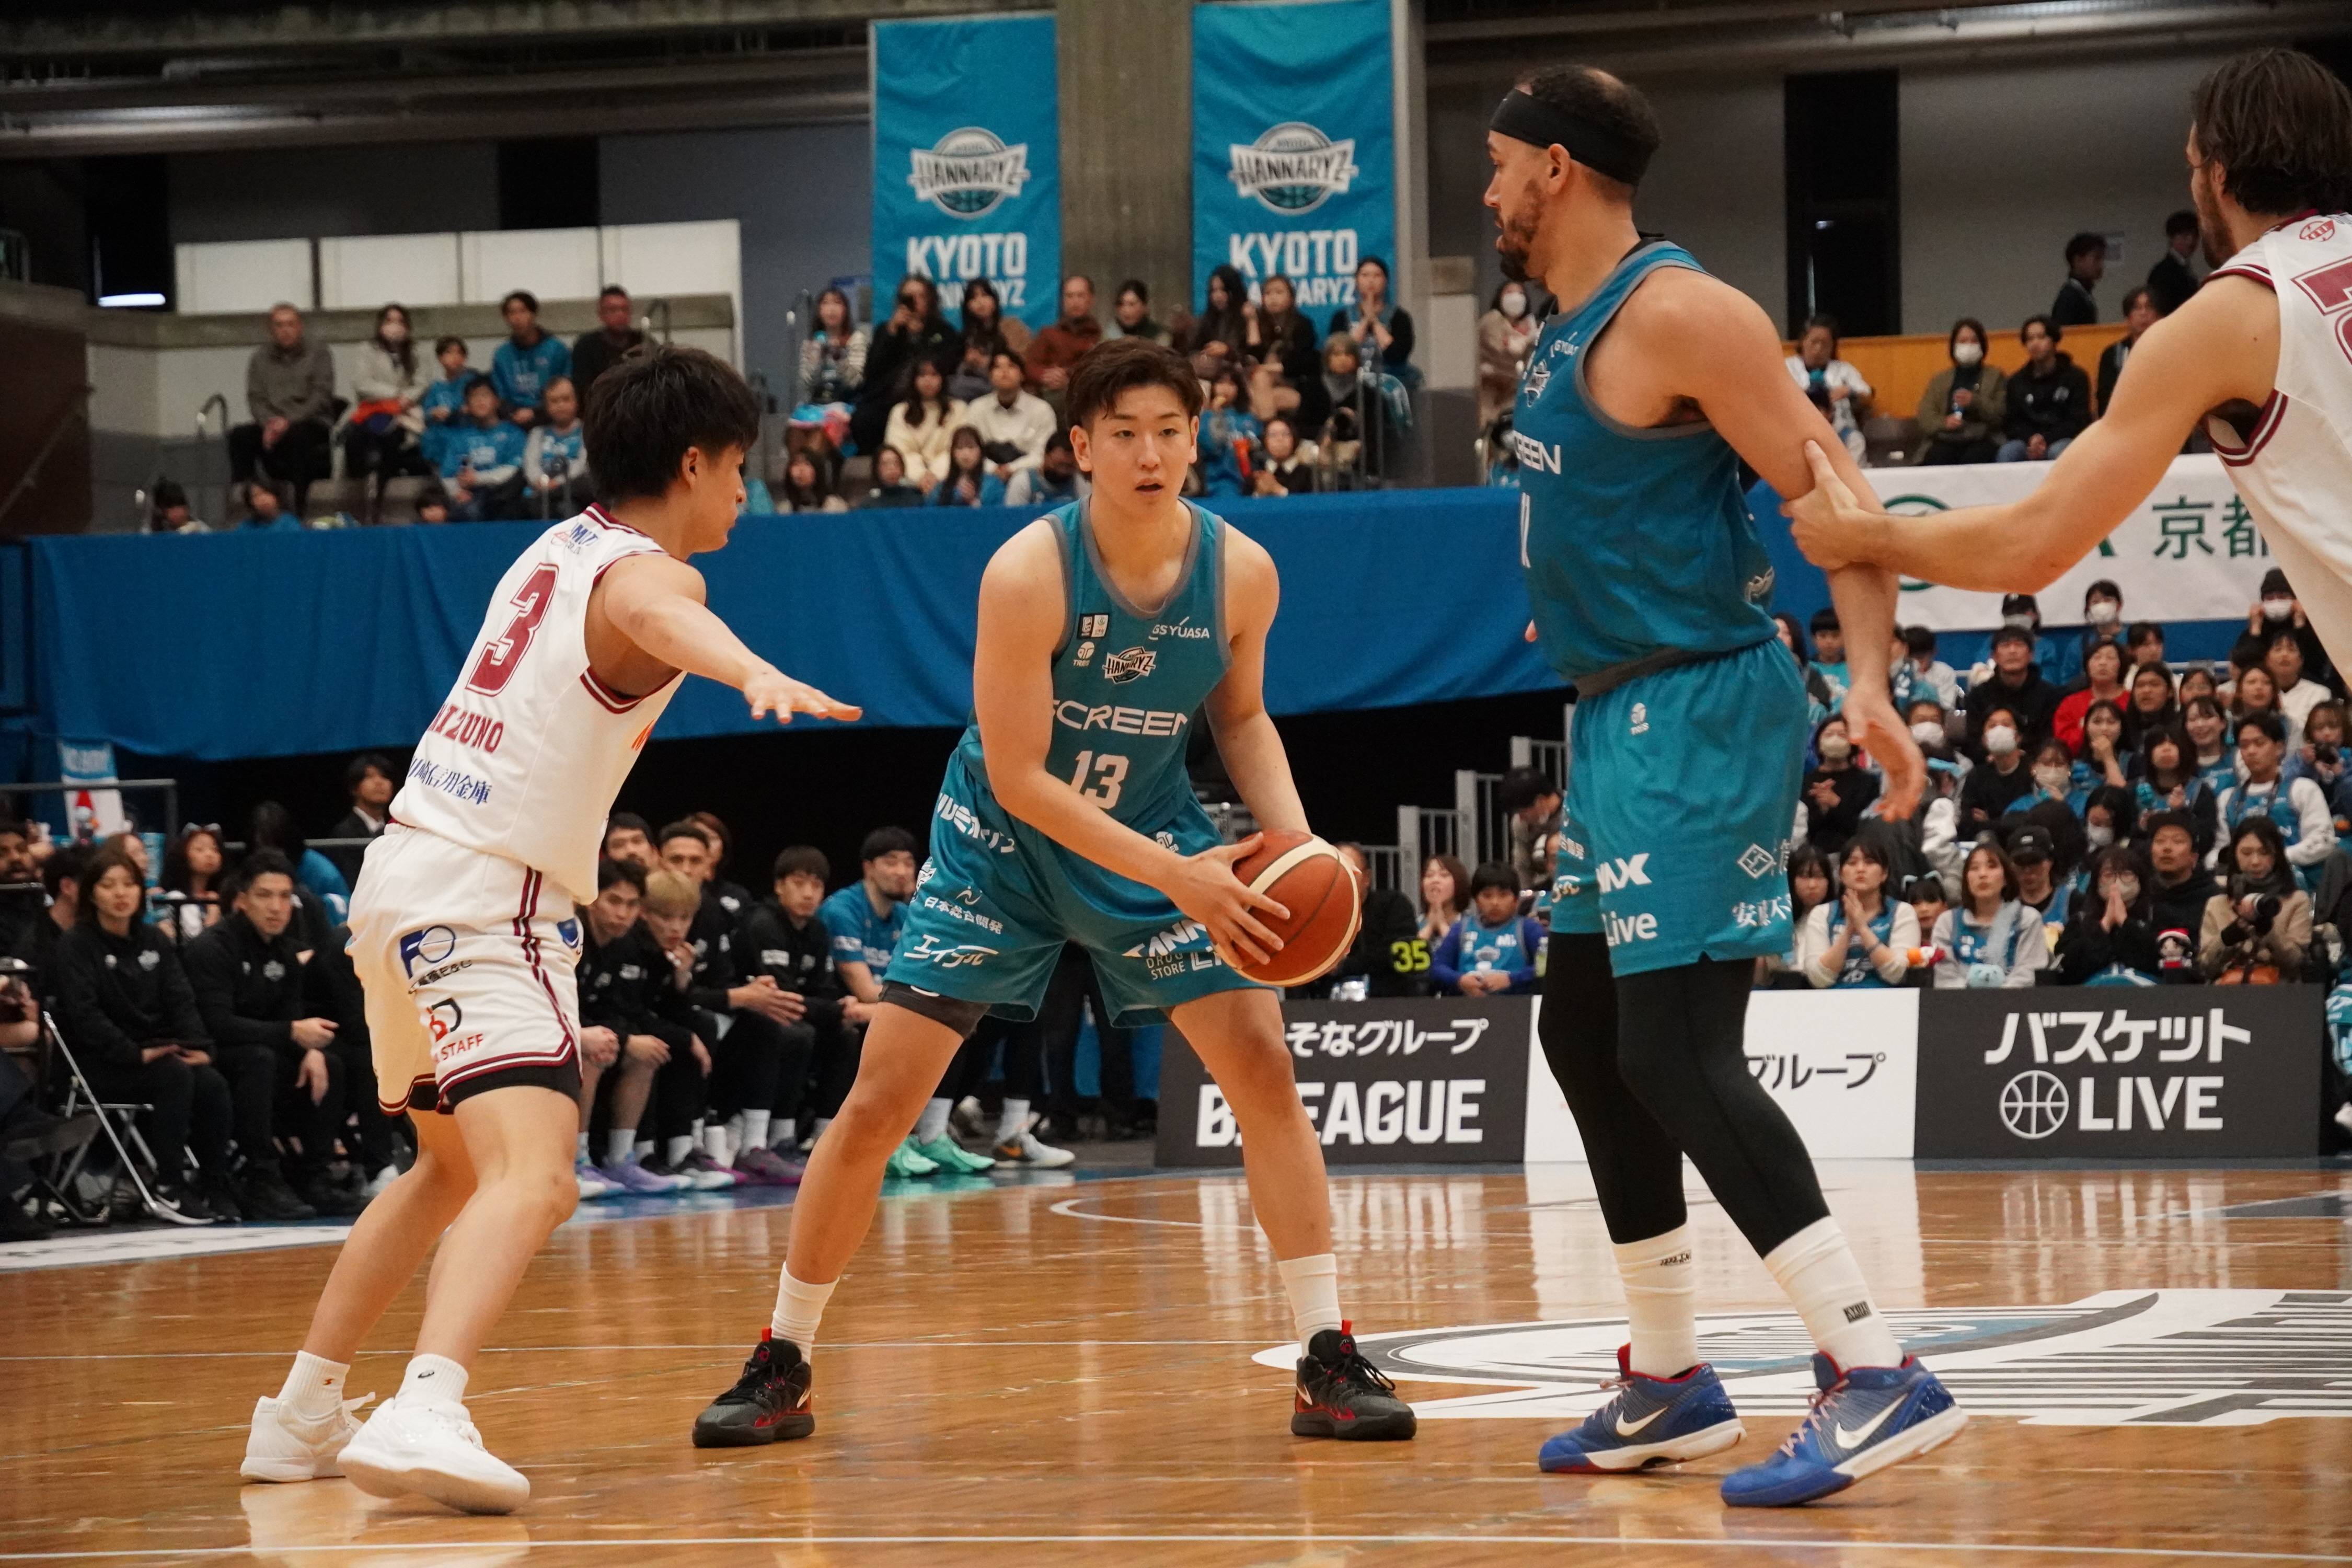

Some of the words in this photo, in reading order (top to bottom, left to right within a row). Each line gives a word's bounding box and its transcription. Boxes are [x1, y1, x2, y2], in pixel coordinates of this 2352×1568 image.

[906, 232, 1028, 280] KYOTO
[1230, 228, 1358, 279] KYOTO
[465, 562, 559, 697] 3
[429, 704, 505, 754] IZUNO
[1070, 750, 1129, 810] 13
[1146, 953, 1184, 969] DRUG
[1151, 961, 1186, 981] STORE
[1391, 939, 1431, 973] 35
[440, 1033, 485, 1060] STAFF
[1284, 1017, 1490, 1057] そなグループ
[1984, 1008, 2252, 1065] バスケット
[2078, 1076, 2224, 1131] LIVE
